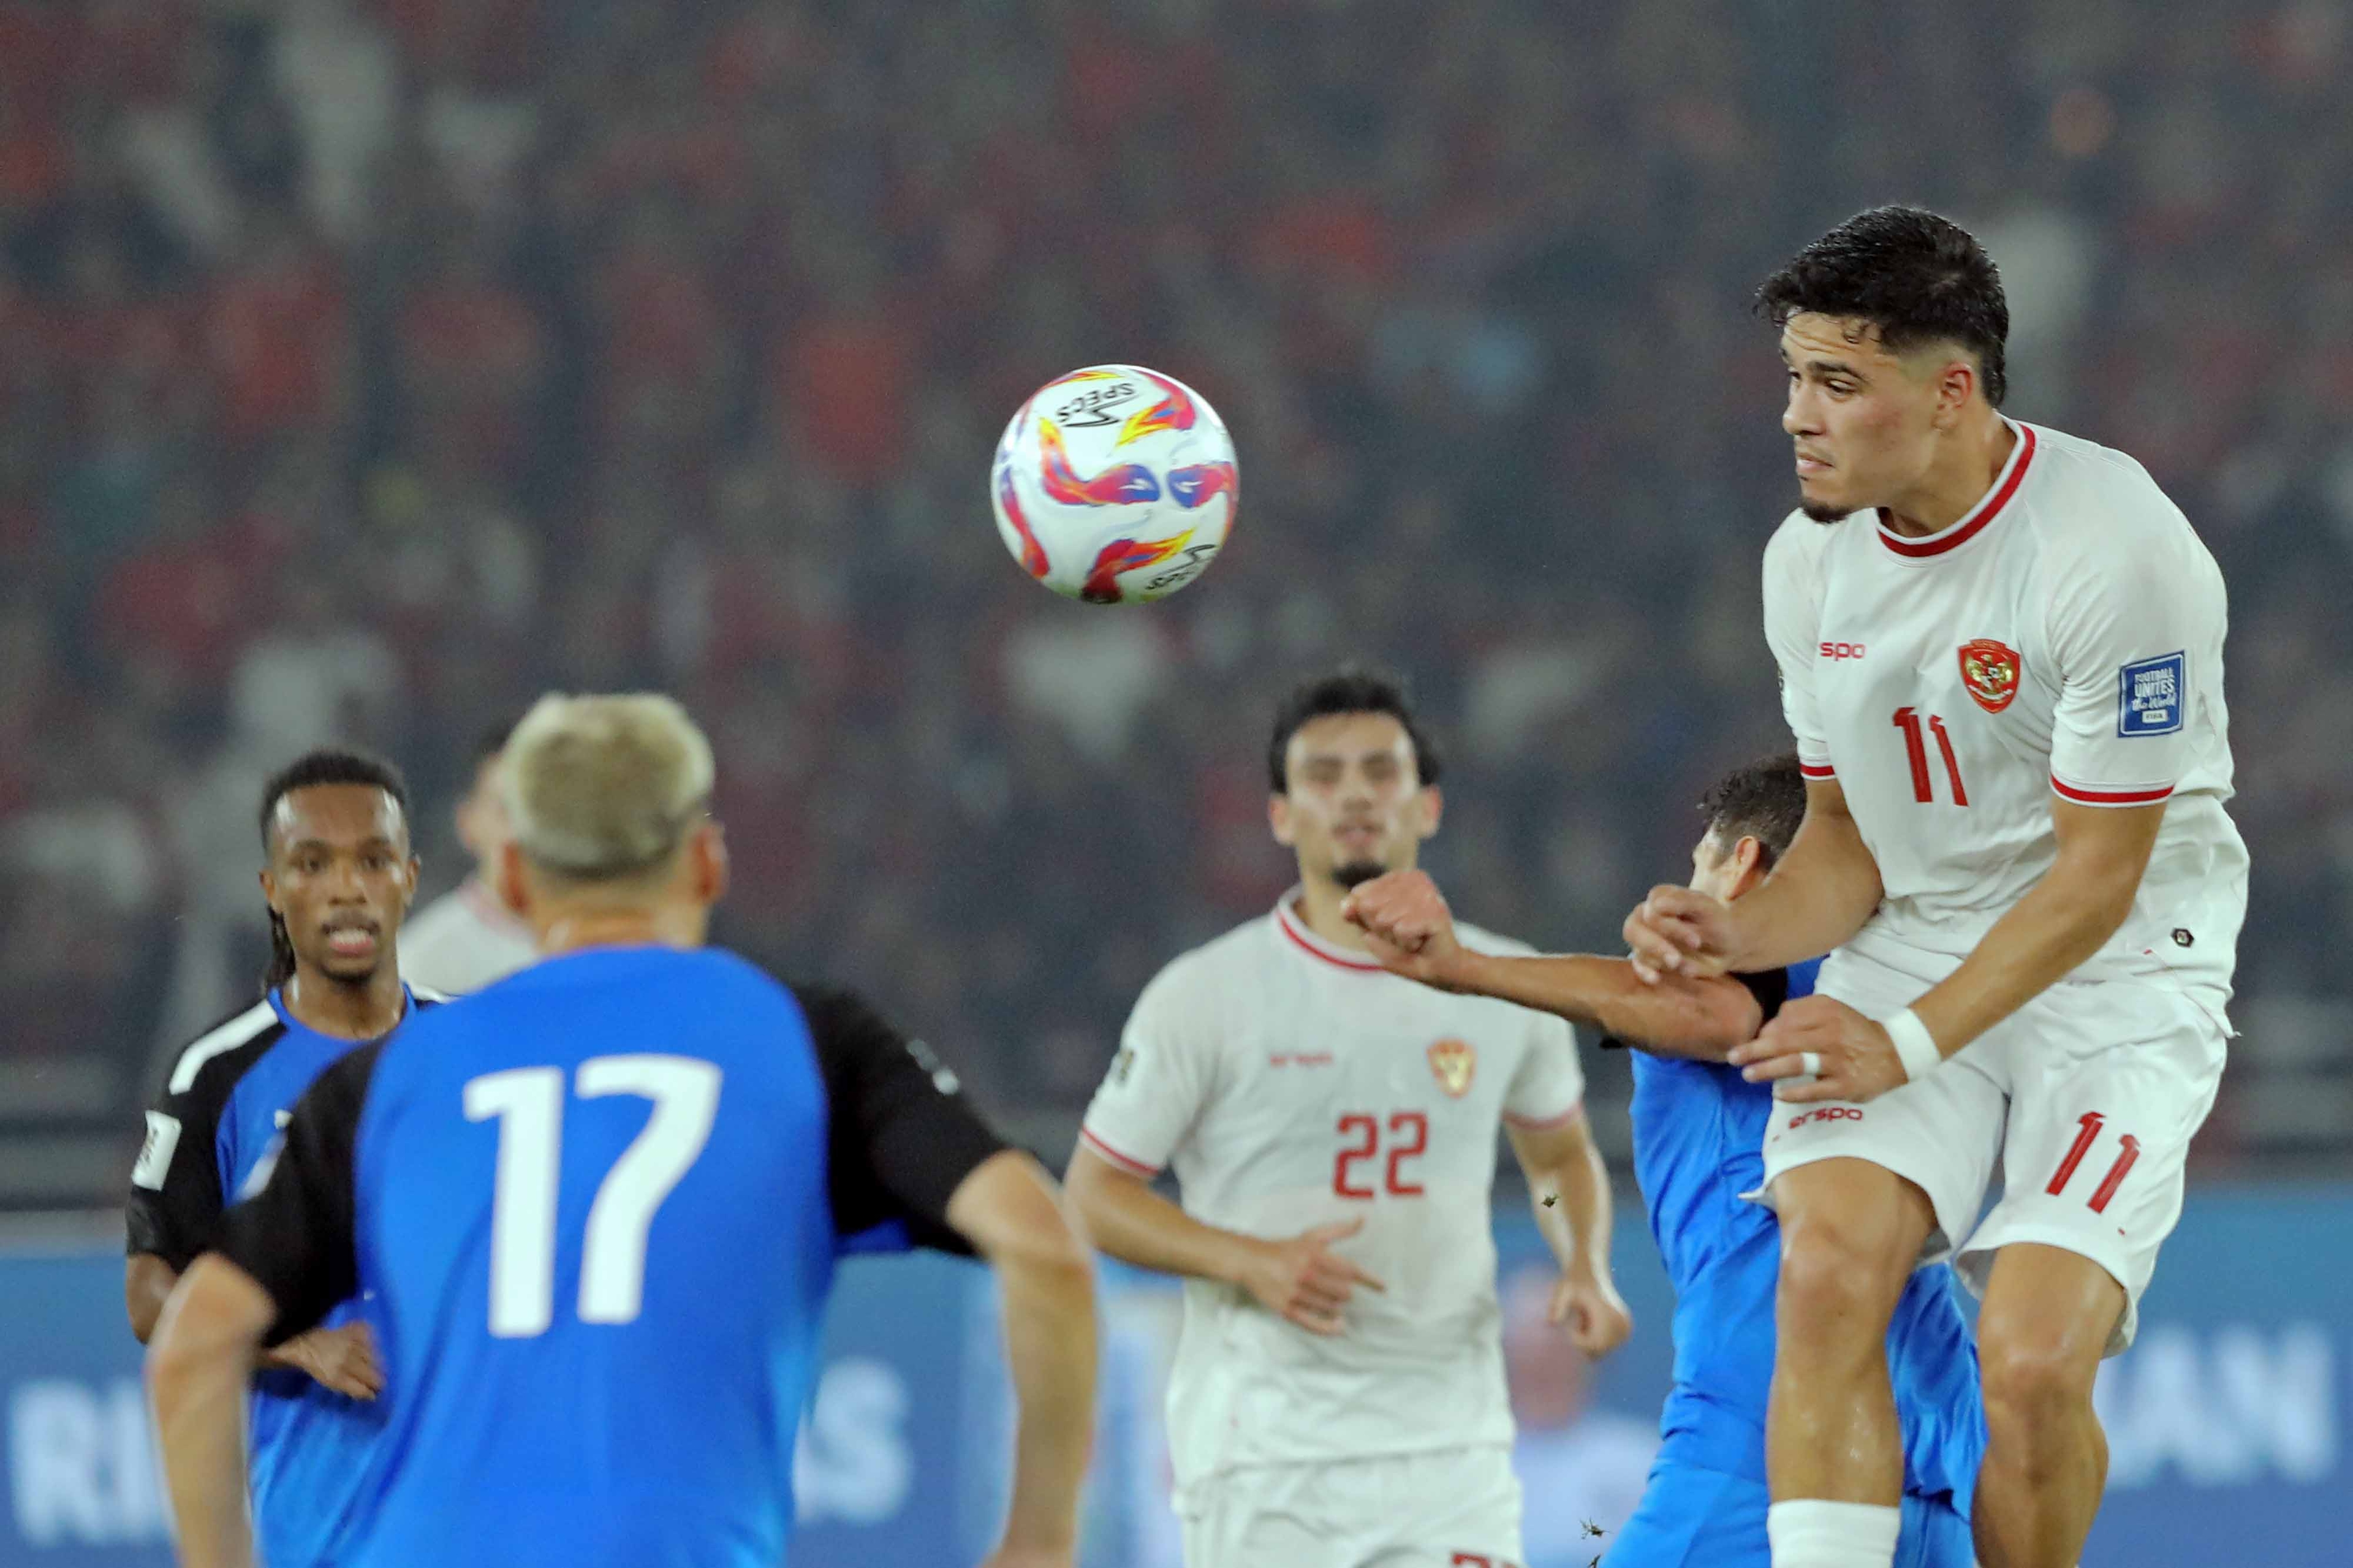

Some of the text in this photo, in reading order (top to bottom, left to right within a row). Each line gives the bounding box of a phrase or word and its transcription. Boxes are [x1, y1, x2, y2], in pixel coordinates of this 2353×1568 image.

[1056, 382, 1135, 423] SPECS
[2134, 667, 2175, 684] FOOTBALL
[2134, 679, 2175, 698] UNITES
[1893, 707, 1968, 807] 11
[463, 1053, 723, 1338] 17
[1332, 1110, 1429, 1199] 22
[2045, 1112, 2140, 1214] 11
